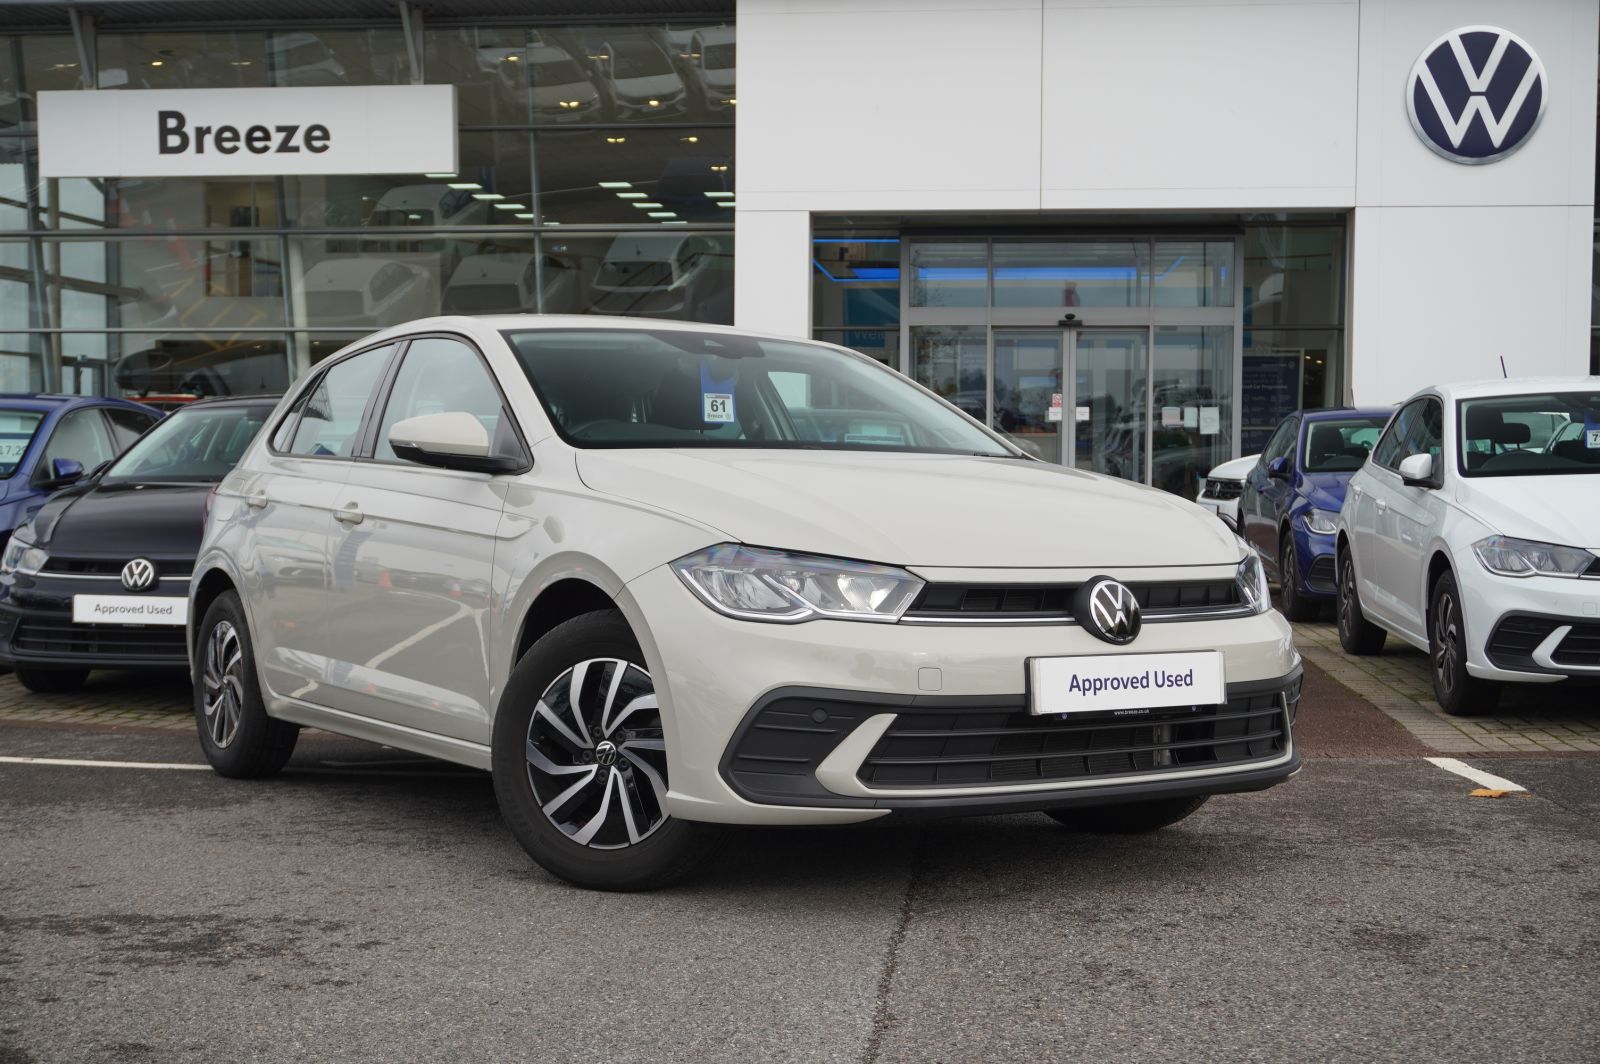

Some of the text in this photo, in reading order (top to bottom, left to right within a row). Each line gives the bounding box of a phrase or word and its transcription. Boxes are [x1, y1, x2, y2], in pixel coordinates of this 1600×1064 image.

[157, 110, 331, 155] Breeze
[711, 400, 726, 412] 61
[1592, 433, 1600, 442] 7
[94, 604, 173, 615] Approved Used
[1068, 669, 1193, 697] Approved Used
